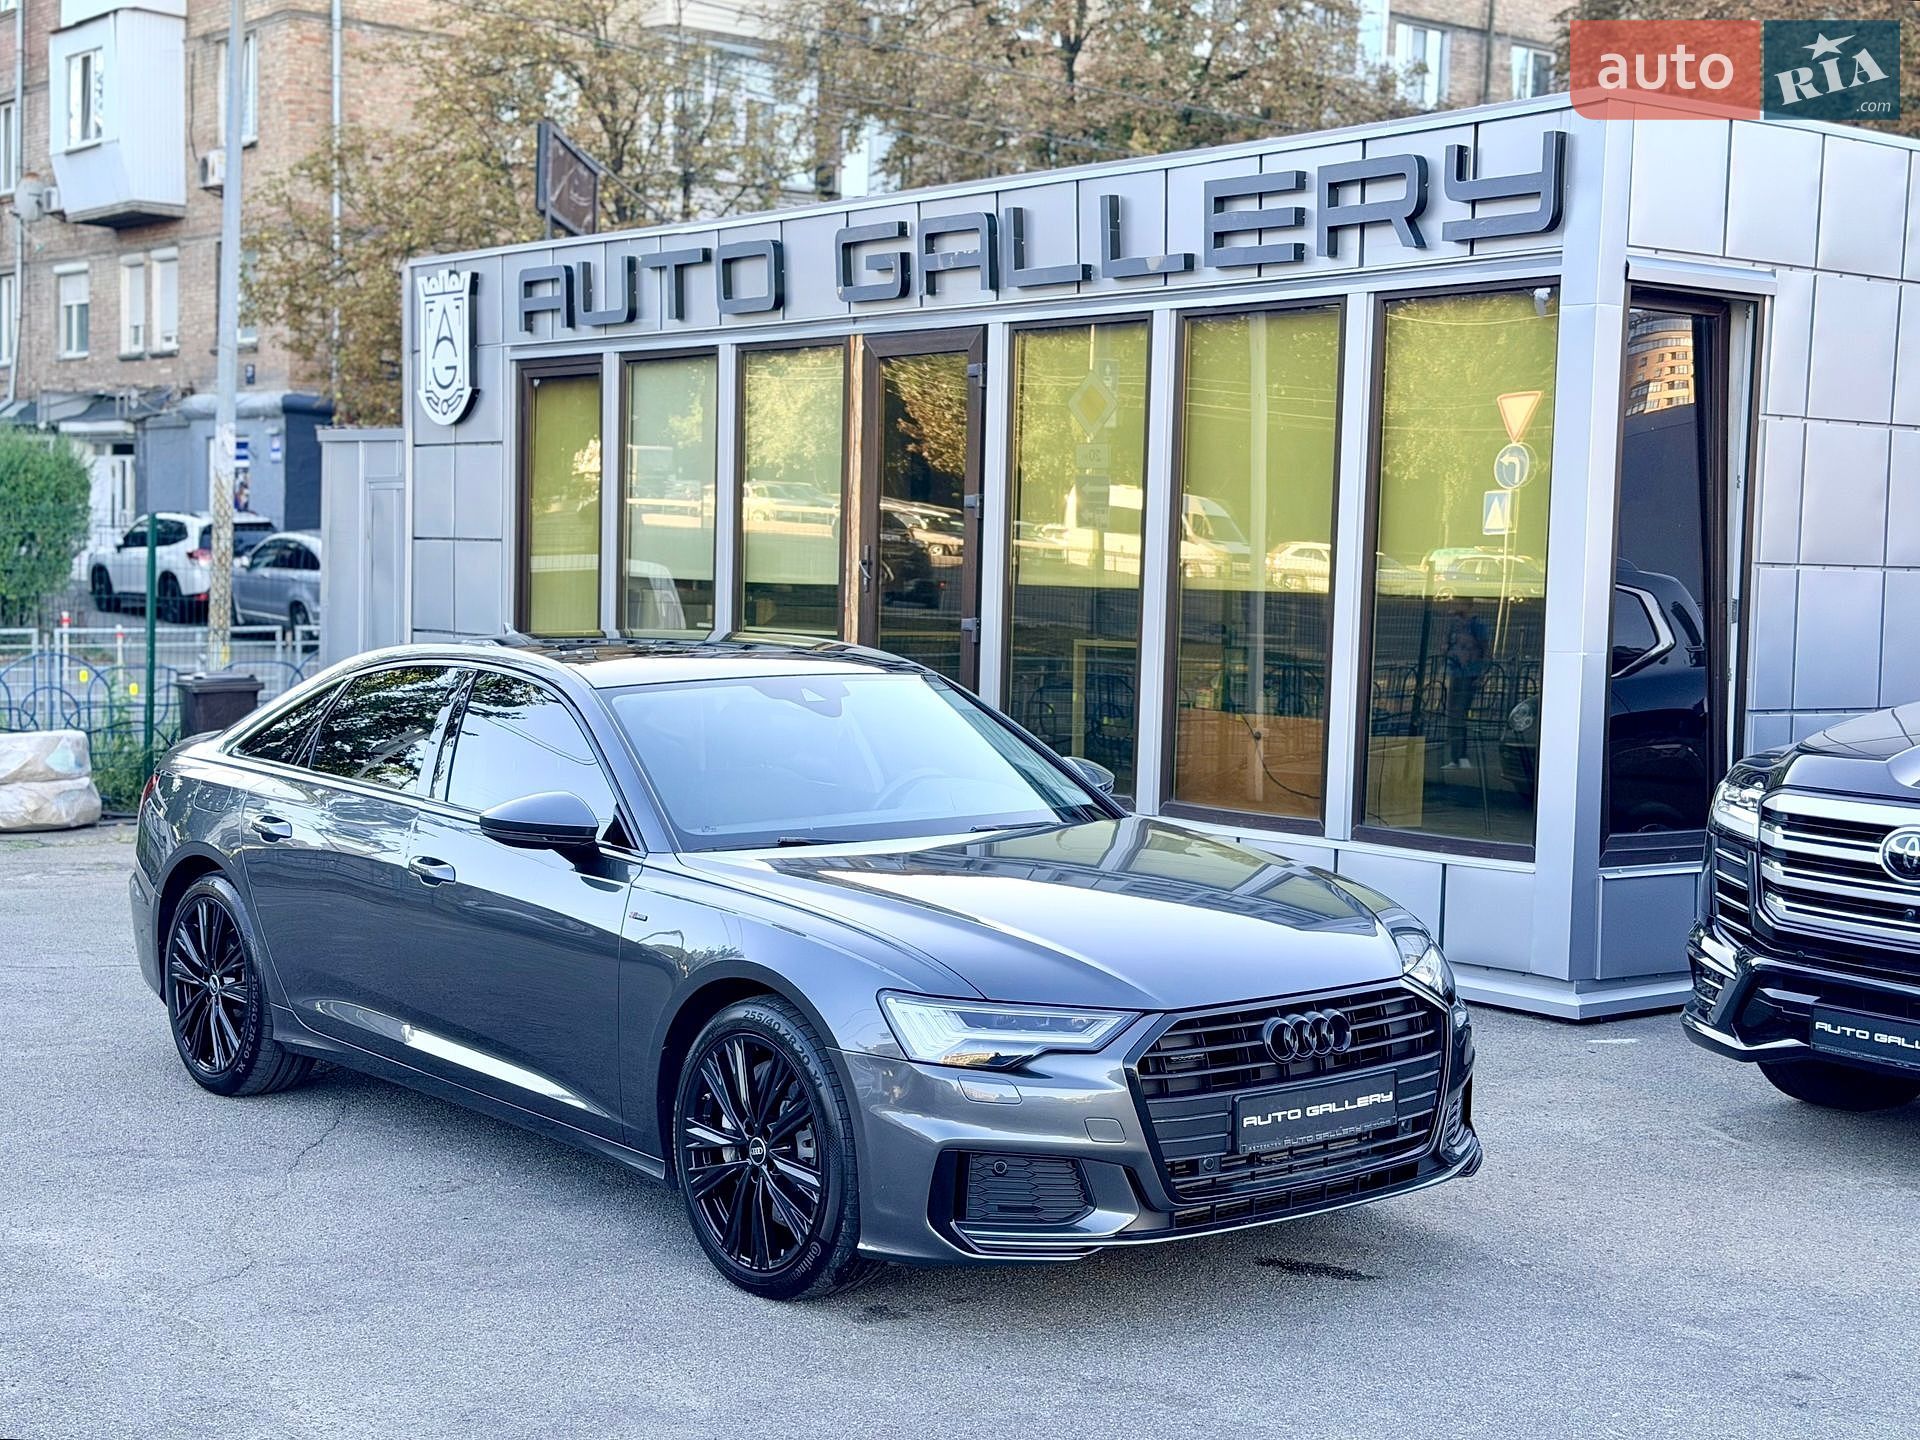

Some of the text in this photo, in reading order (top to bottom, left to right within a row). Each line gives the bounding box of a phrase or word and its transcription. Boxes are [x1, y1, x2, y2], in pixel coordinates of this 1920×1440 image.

[518, 130, 1567, 334] AUTO GALLERY
[743, 1009, 781, 1032] 255/40
[782, 1028, 797, 1048] ZR
[797, 1046, 810, 1066] 20
[1815, 1021, 1870, 1040] AUTO
[1242, 1091, 1394, 1128] AUTO GALLERY
[1283, 1134, 1314, 1147] AUTO
[1315, 1125, 1362, 1141] GALLERY
